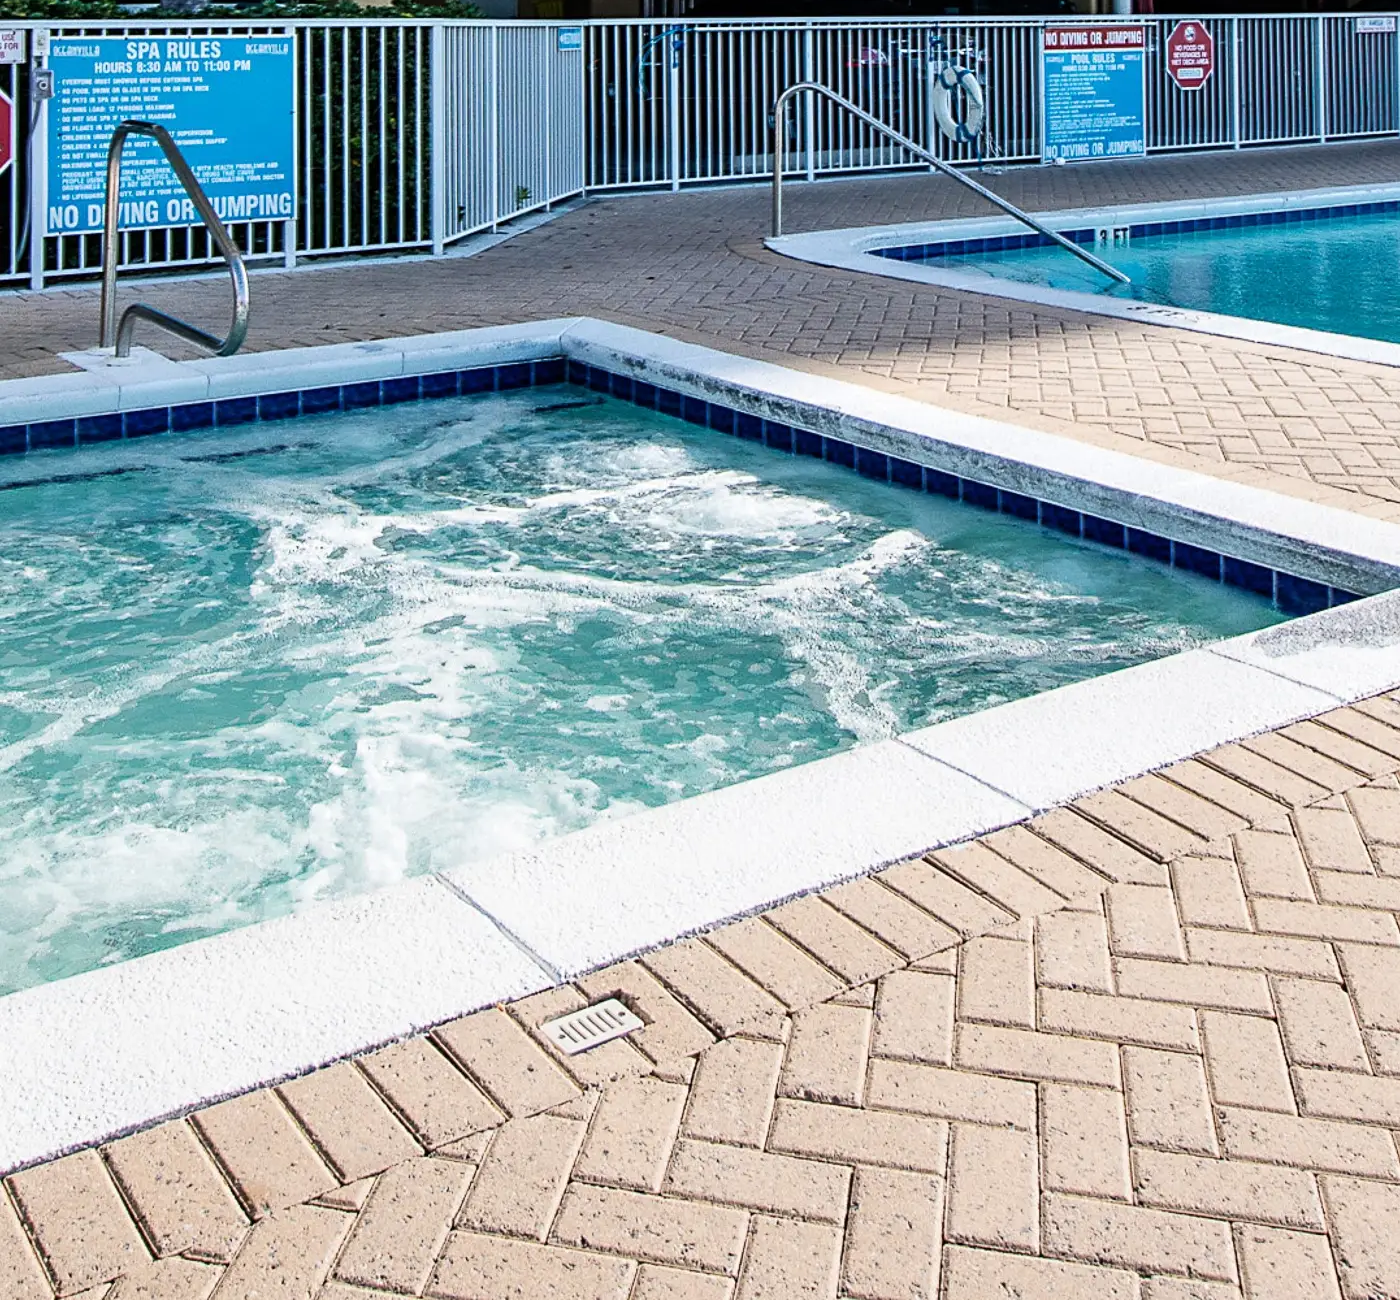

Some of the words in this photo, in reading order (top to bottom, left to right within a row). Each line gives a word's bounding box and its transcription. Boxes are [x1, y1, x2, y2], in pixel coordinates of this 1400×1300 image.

[1045, 32, 1057, 46] NO
[1060, 31, 1088, 46] DIVING
[1090, 31, 1103, 45] OR
[1104, 30, 1142, 44] JUMPING
[126, 41, 160, 60] SPA
[167, 41, 221, 59] RULES
[1071, 53, 1090, 64] POOL
[1092, 53, 1116, 63] RULES
[94, 61, 132, 74] HOURS
[136, 61, 161, 73] 8:30
[164, 61, 181, 73] AM
[185, 60, 199, 72] TO
[203, 60, 231, 72] 11:00
[234, 59, 251, 71] PM
[1045, 145, 1058, 158] NO
[1061, 143, 1090, 157] DIVING
[1092, 142, 1104, 155] OR
[1107, 140, 1143, 154] JUMPING
[49, 204, 79, 229] NO
[166, 199, 195, 221] OR
[208, 192, 292, 219] UMPING
